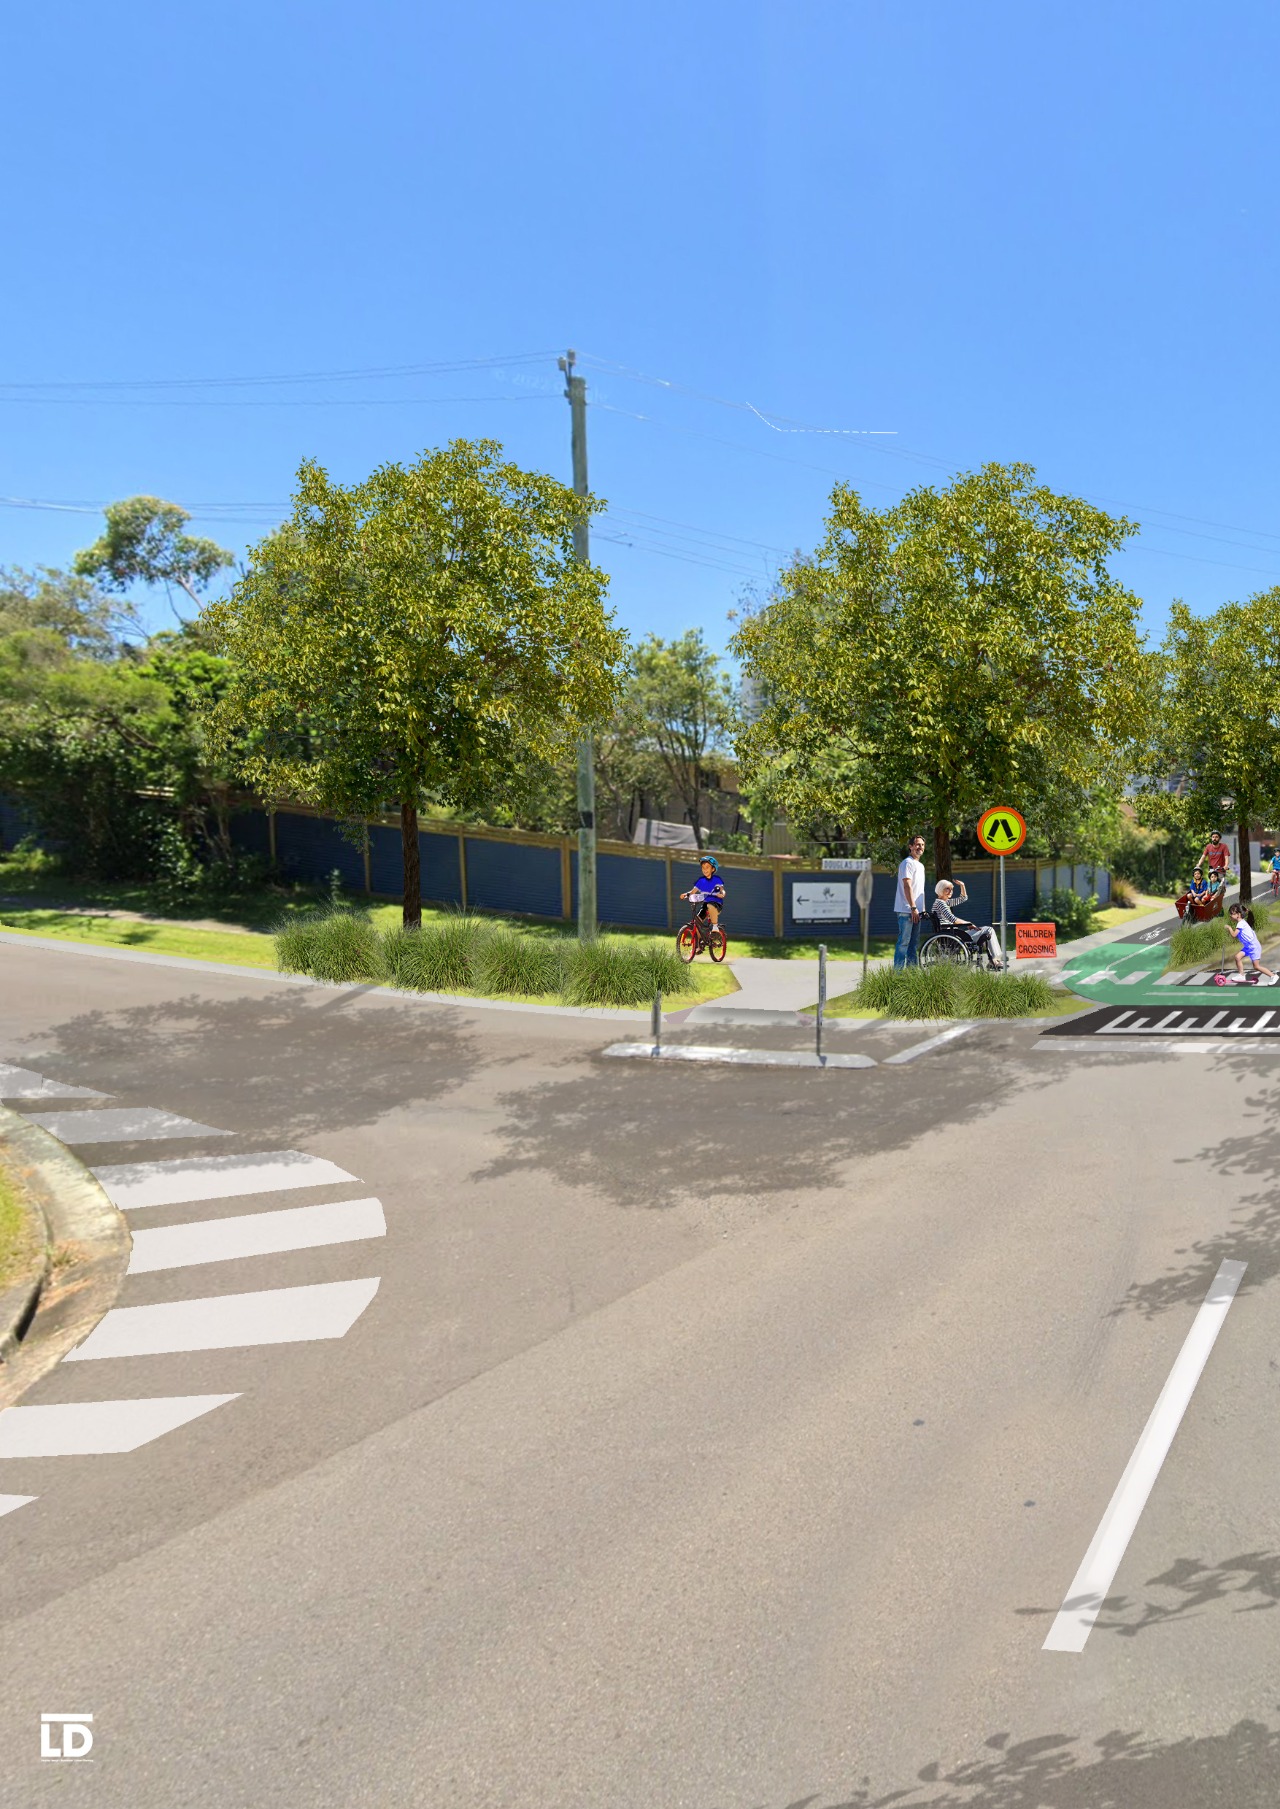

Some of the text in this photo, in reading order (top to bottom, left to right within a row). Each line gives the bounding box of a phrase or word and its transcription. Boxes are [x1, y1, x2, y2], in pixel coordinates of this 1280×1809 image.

[824, 860, 864, 869] DOUGLAS ST
[1017, 929, 1053, 938] CHILDREN
[1018, 944, 1055, 954] CROSSING
